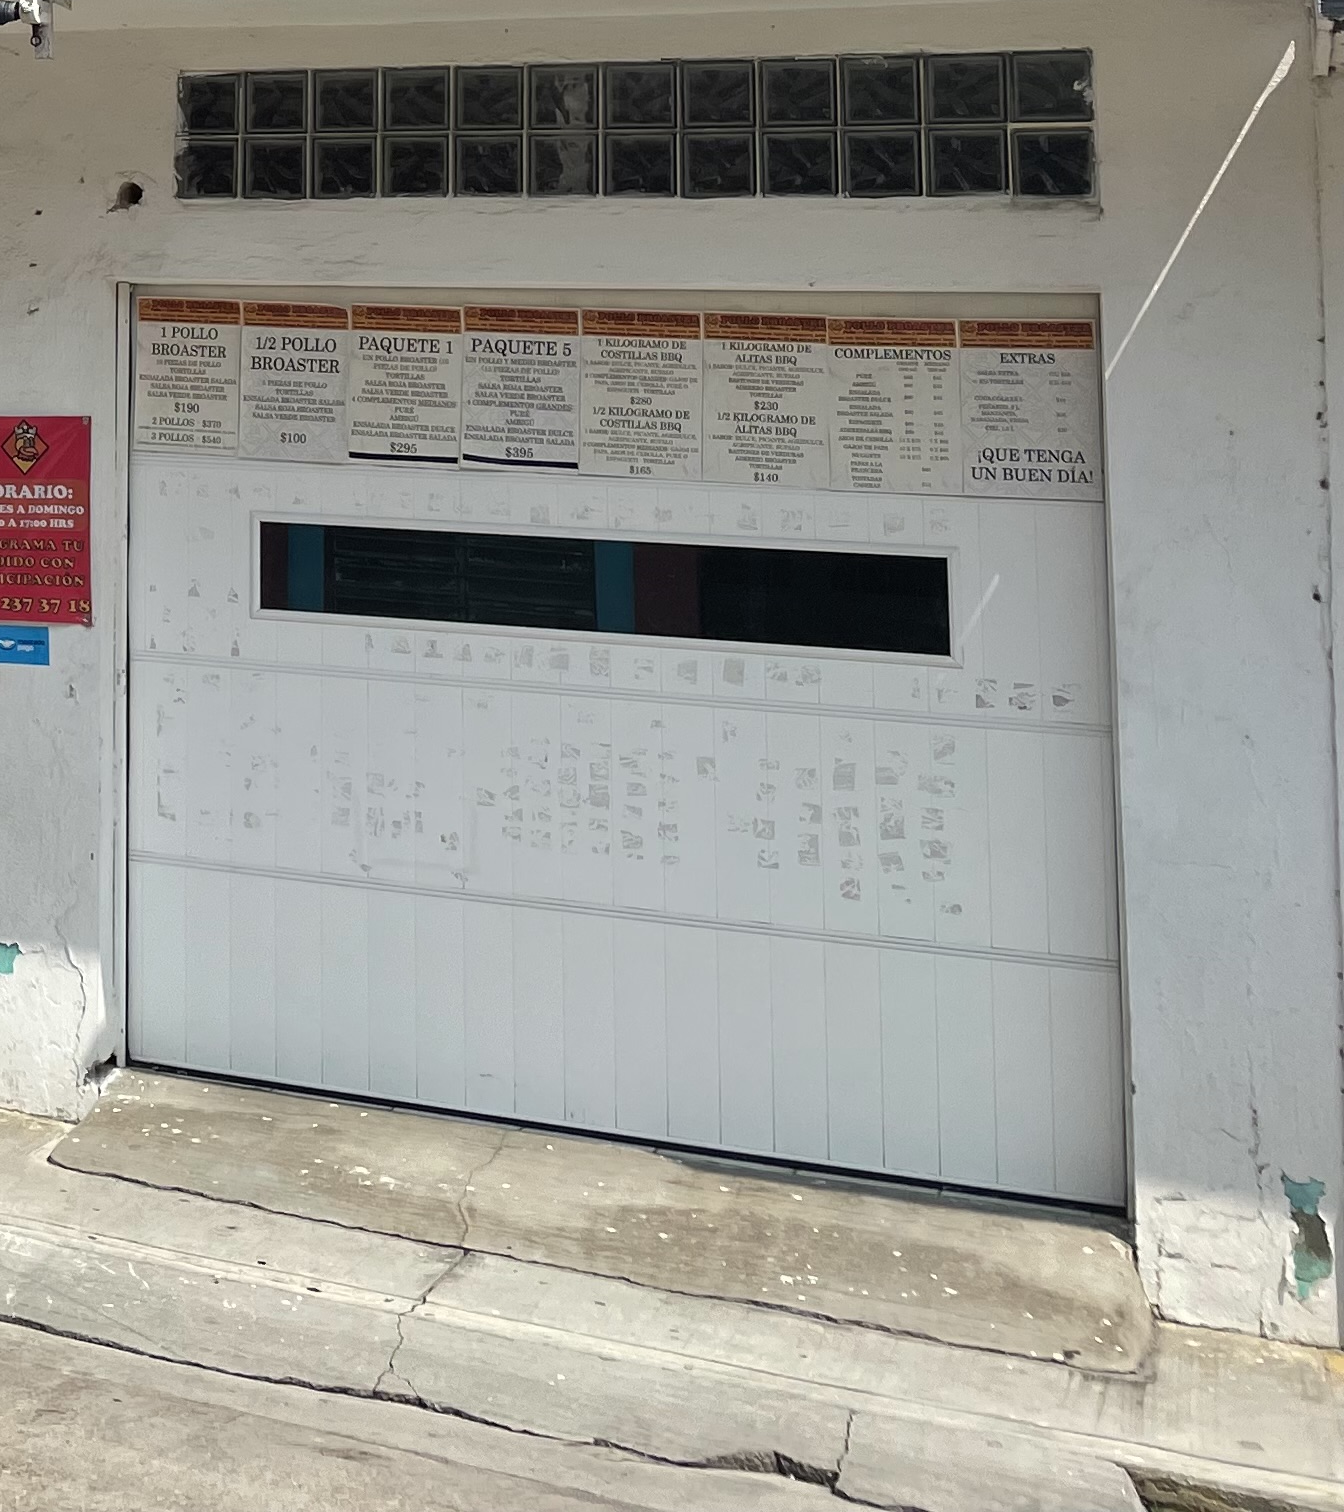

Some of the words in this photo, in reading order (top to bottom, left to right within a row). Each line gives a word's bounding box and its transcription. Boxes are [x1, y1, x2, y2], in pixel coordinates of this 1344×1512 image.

[160, 327, 166, 338] 1
[172, 327, 218, 340] POLLO
[152, 342, 227, 359] BROASTER
[256, 337, 276, 350] 1/2
[281, 337, 337, 352] POLLO
[358, 336, 440, 354] PAQUETE
[446, 341, 453, 354] 1
[471, 338, 557, 357] PAQUETE
[563, 343, 572, 356] 5
[605, 339, 669, 350] KILOGRAMO
[672, 341, 687, 350] DE
[729, 341, 794, 353] KILOGRAMO
[796, 345, 812, 353] DE
[600, 350, 658, 361] COSTILLAS
[660, 352, 682, 363] BBQ
[735, 354, 773, 364] ALITAS
[775, 355, 798, 366] BBQ
[834, 348, 952, 361] COMPLEMENTOS
[1000, 352, 1055, 365] EXTRAS
[251, 356, 340, 374] BROASTER
[630, 396, 652, 405] $280
[754, 401, 778, 411] $230
[174, 402, 200, 413] $190
[593, 406, 605, 415] 1/2
[608, 407, 673, 419] KILOGRAMO
[675, 410, 690, 420] DE
[158, 418, 195, 427] POLLOS
[717, 412, 730, 421] 1/2
[733, 412, 798, 425] KILOGRAMO
[801, 415, 816, 426] DE
[599, 418, 658, 430] COSTILLAS
[660, 421, 682, 433] BBQ
[734, 424, 773, 435] ALITAS
[775, 427, 797, 437] BBQ
[158, 433, 194, 443] POLLOS
[280, 432, 307, 443] $100
[390, 442, 418, 454] $295
[505, 447, 533, 458] $395
[978, 448, 1020, 464] ¡QUE
[1023, 449, 1085, 465] TENGA
[629, 465, 651, 475] $165
[971, 466, 996, 481] UN
[1003, 467, 1052, 483] BUEN
[1057, 467, 1093, 484] DÍA!
[753, 472, 778, 482] $140
[16, 505, 26, 514] A
[28, 505, 85, 515] DOMINGO
[8, 519, 17, 527] A
[19, 519, 47, 528] 17:00
[49, 519, 74, 528] HRS
[62, 540, 85, 552] TU
[40, 557, 75, 569] CON
[1, 597, 33, 613] 237
[39, 598, 61, 614] 37
[68, 599, 92, 614] 18
